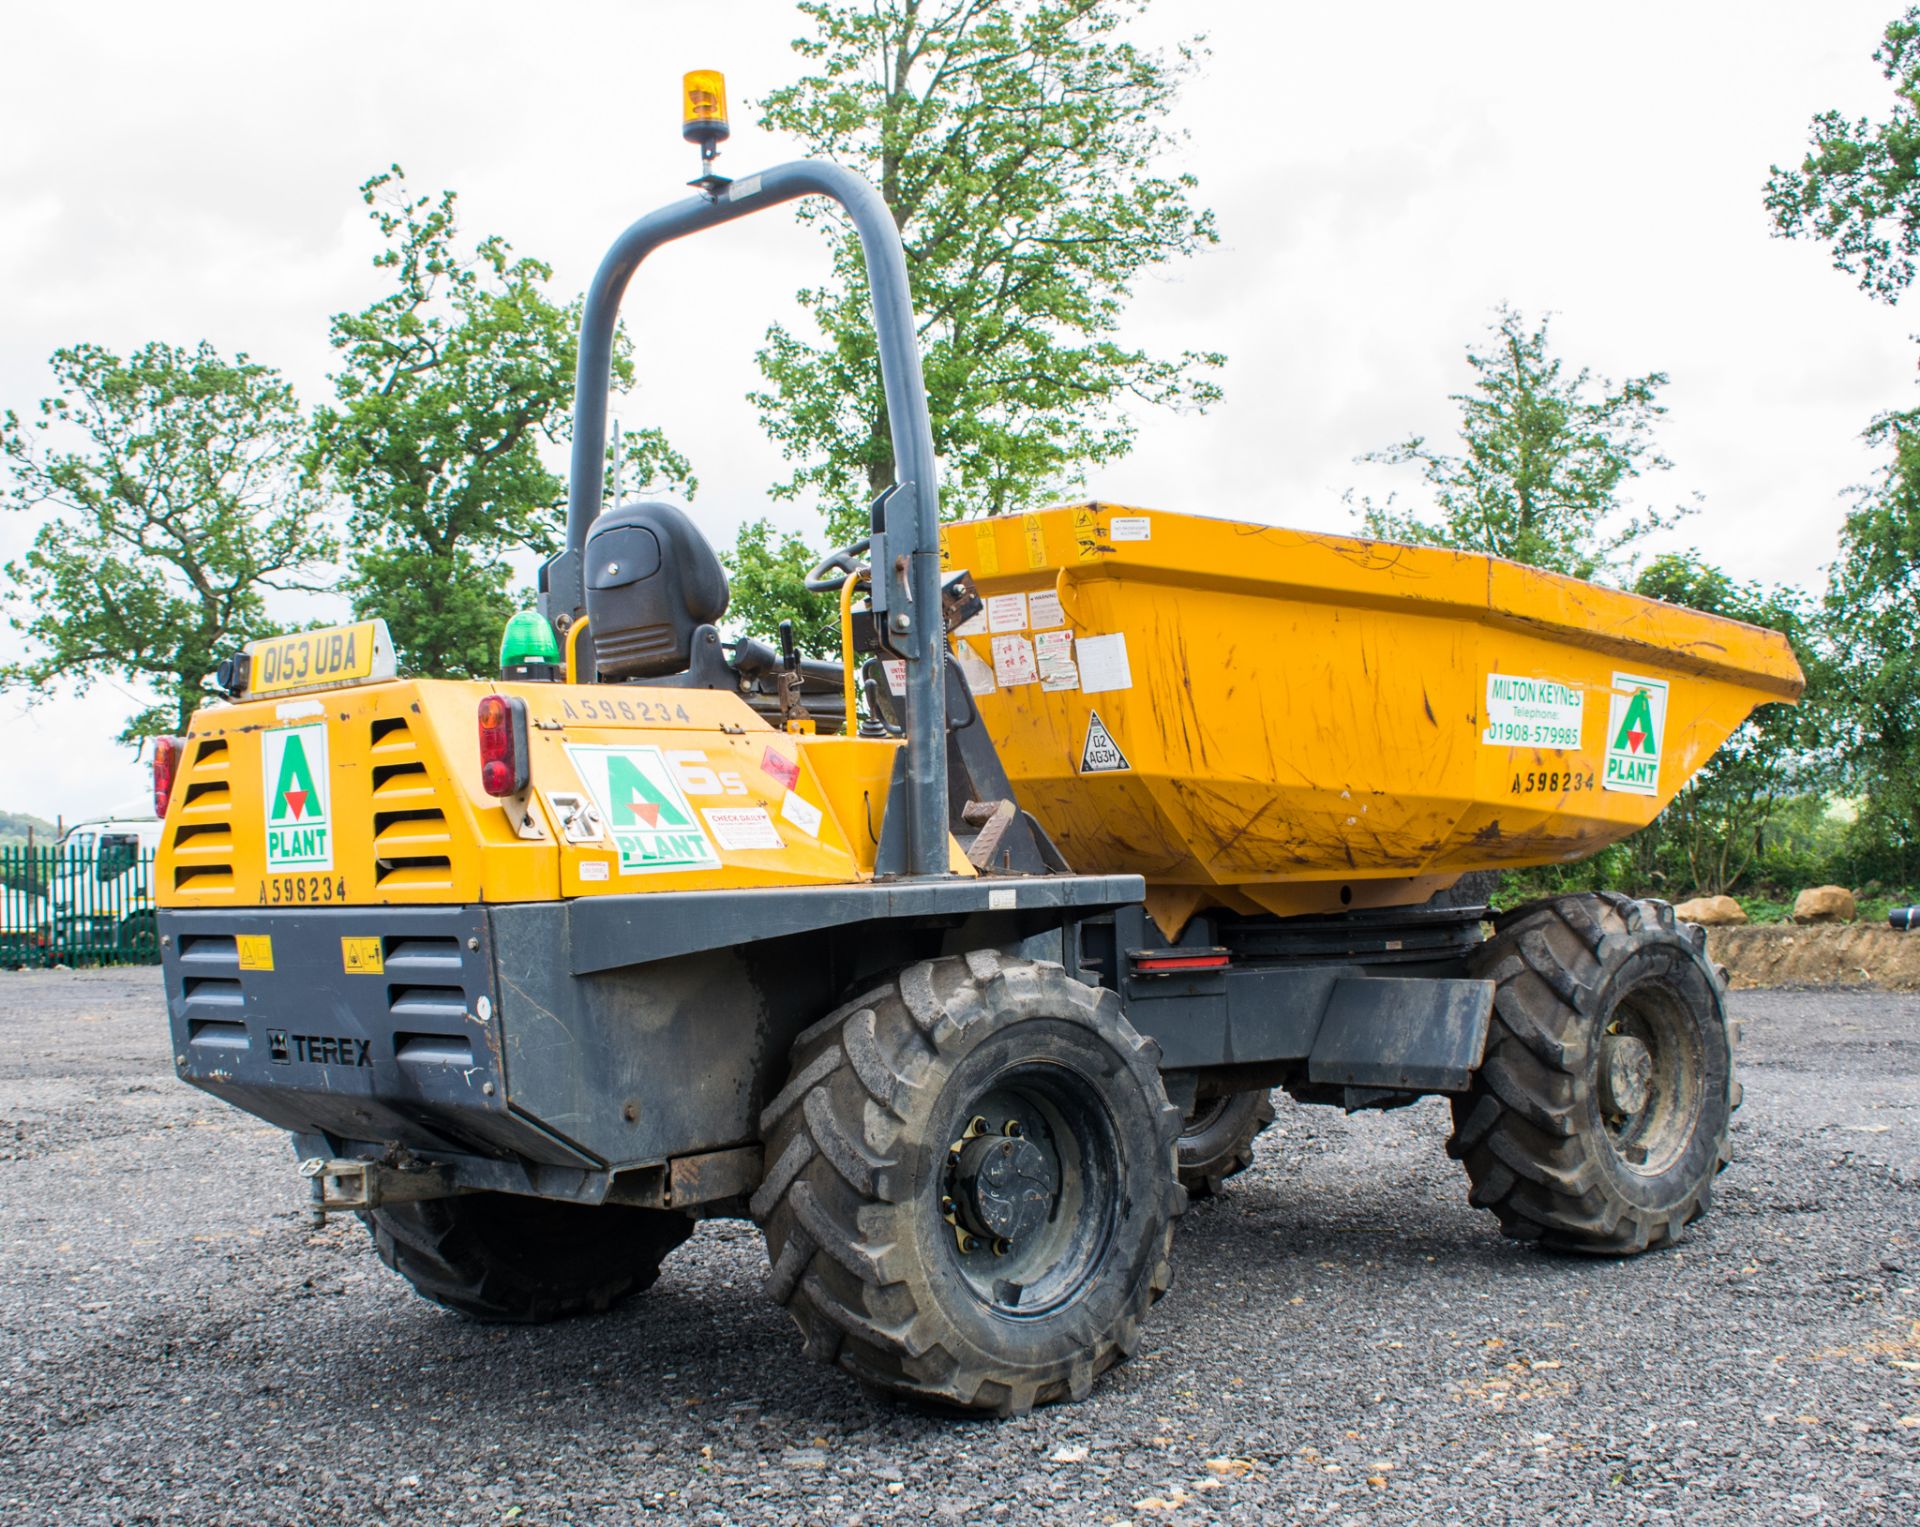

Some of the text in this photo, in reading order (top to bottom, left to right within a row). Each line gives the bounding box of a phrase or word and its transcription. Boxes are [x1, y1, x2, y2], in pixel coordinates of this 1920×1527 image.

[264, 631, 356, 683] Q153 UBA
[1492, 678, 1581, 707] MILTON KEYNES
[1513, 706, 1560, 720] Telephone:
[1613, 688, 1657, 755] A
[1489, 722, 1579, 746] 01908-579985
[1090, 749, 1117, 764] AG3H
[1607, 758, 1657, 784] PLANT
[271, 734, 323, 821] A
[606, 755, 691, 828] A
[269, 828, 327, 858] PLANT
[615, 834, 709, 861] PLANT
[259, 876, 346, 905] A598234
[291, 1034, 374, 1068] TEREX
